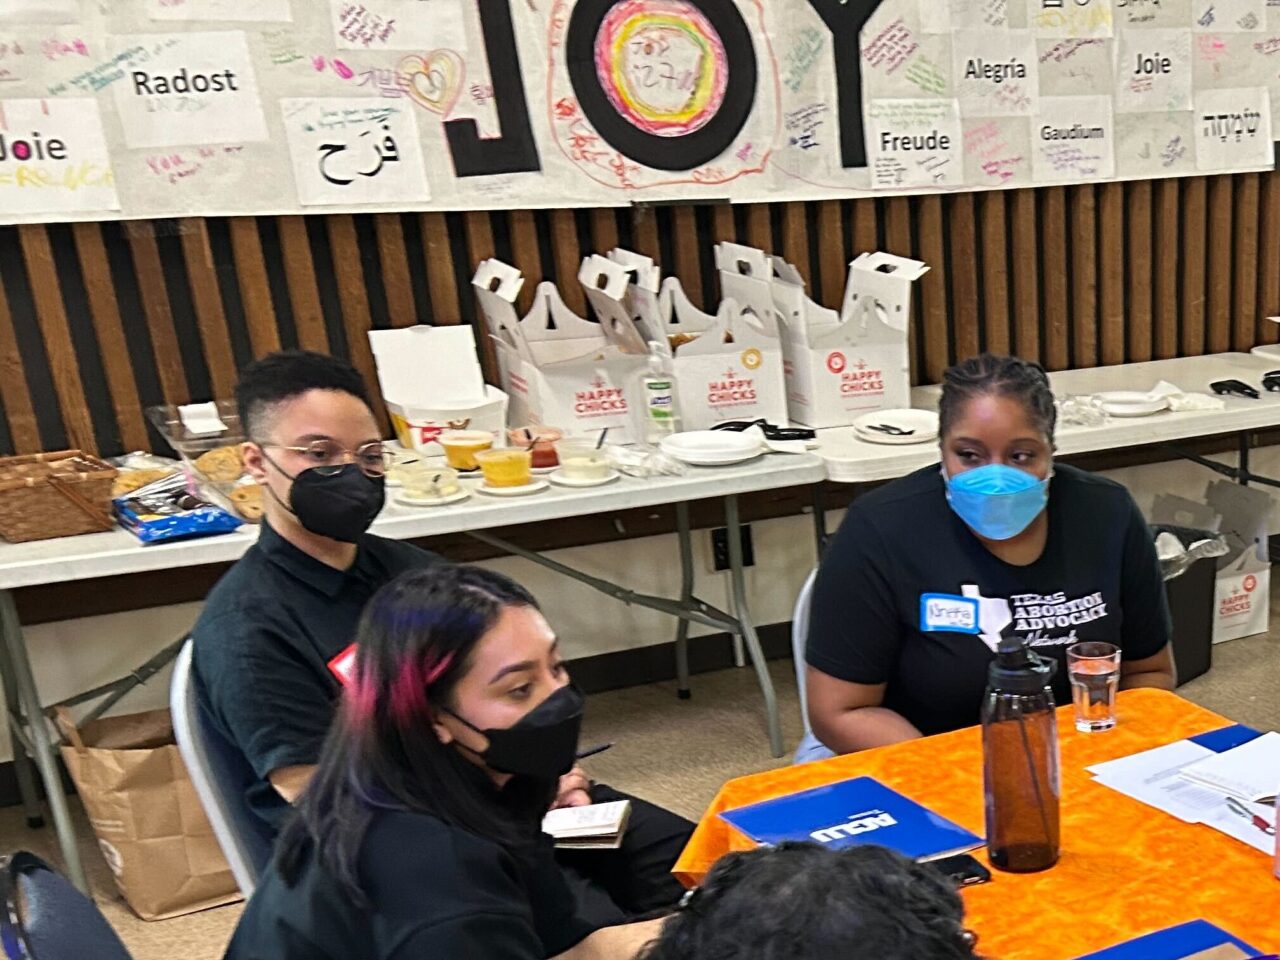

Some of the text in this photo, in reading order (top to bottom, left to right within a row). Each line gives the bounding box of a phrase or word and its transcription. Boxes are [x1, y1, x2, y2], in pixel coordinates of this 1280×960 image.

[965, 57, 1026, 83] Alegría
[1134, 52, 1171, 75] Joie
[132, 68, 239, 95] Radost
[444, 0, 884, 177] JOY
[881, 130, 950, 151] Freude
[1040, 124, 1104, 141] Gaudium
[0, 131, 67, 161] Joie
[708, 379, 753, 392] HAPPY
[840, 380, 883, 392] CHICKS
[842, 370, 881, 381] HAPPY
[575, 388, 623, 402] HAPPY
[708, 389, 757, 403] CHICKS
[575, 399, 627, 413] CHICKS
[1010, 592, 1066, 606] TEXAS
[1014, 592, 1103, 618] ABORTION
[1014, 604, 1108, 631] ADVOCACY
[809, 812, 898, 843] ACLU
